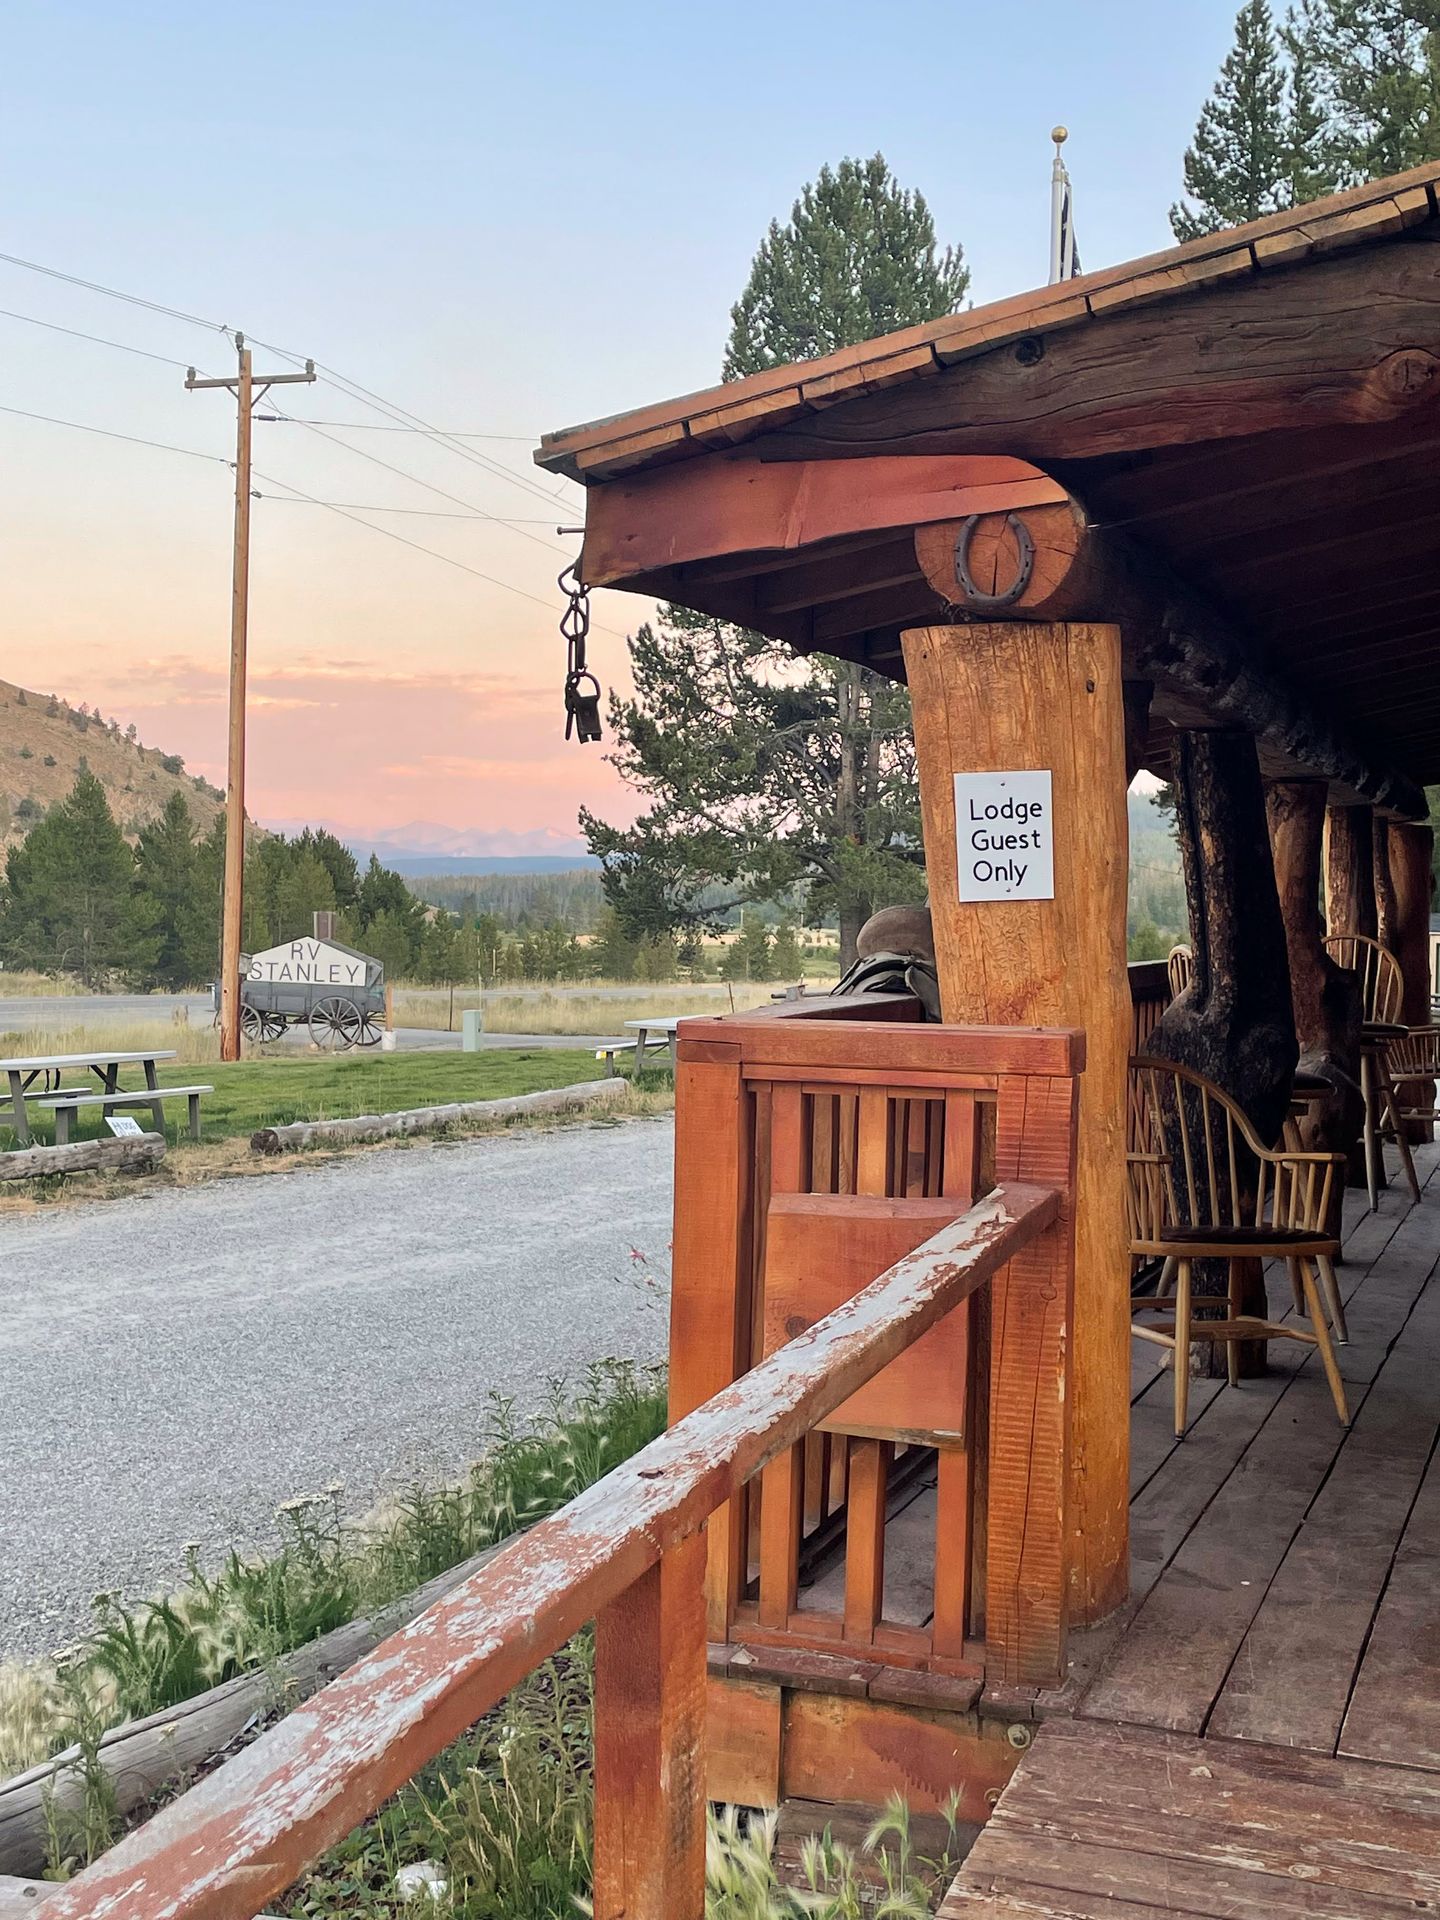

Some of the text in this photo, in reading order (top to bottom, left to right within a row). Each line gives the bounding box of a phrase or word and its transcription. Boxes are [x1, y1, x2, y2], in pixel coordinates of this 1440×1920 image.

[970, 797, 1043, 825] Lodge
[971, 829, 1041, 851] Guest
[973, 859, 1028, 887] Only
[291, 942, 321, 961] RV
[250, 961, 360, 983] STANLEY
